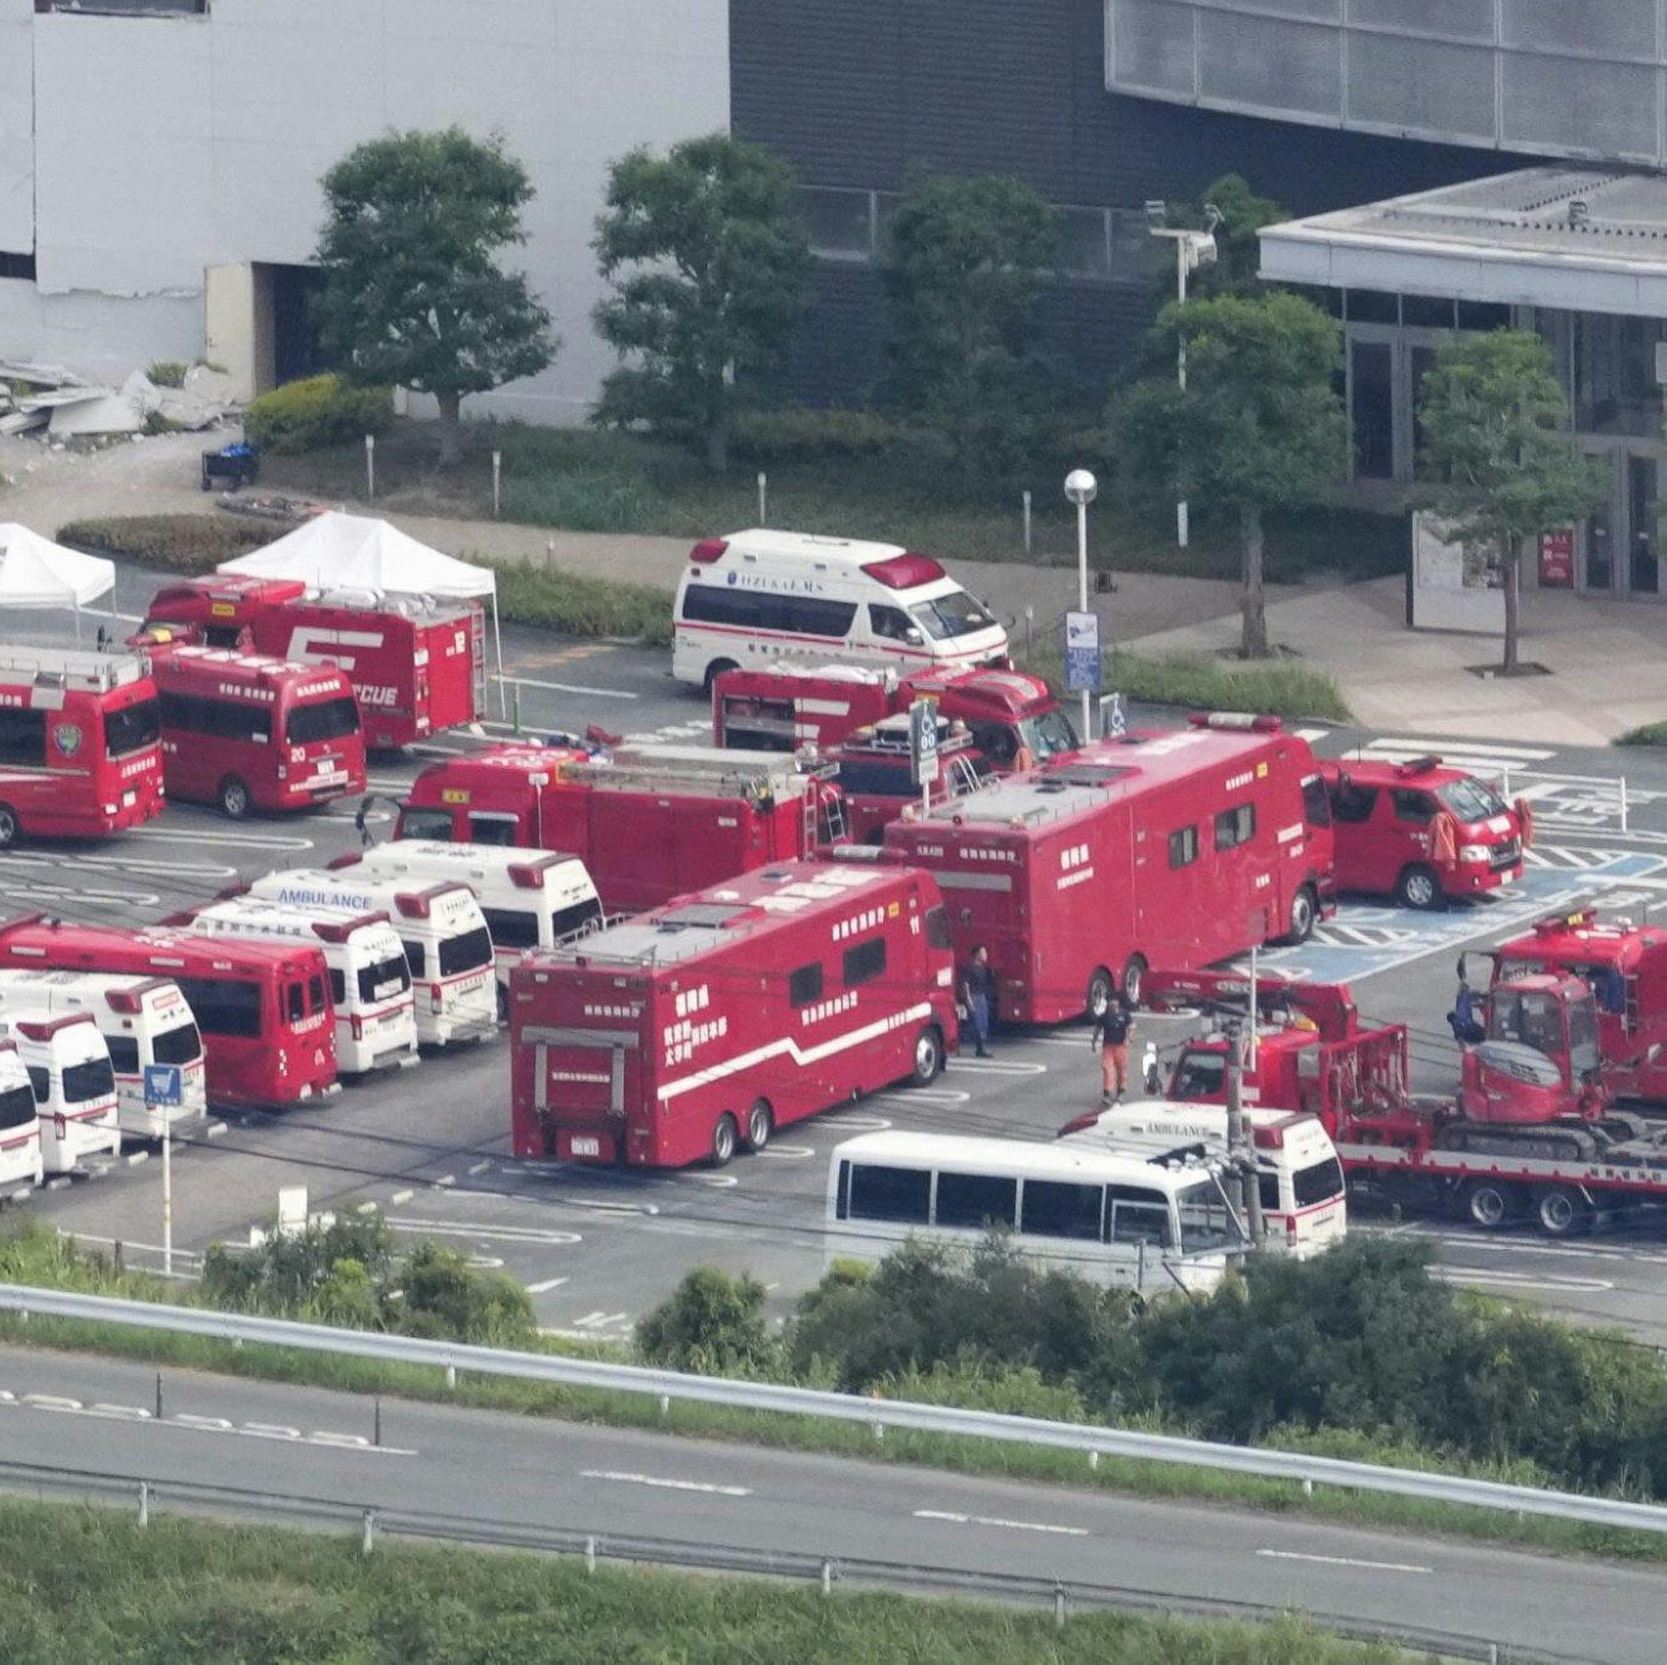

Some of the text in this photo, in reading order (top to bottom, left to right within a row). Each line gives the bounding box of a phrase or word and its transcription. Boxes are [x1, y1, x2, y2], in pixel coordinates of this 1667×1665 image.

[352, 683, 399, 706] CUE
[278, 888, 373, 910] AMBULANCE
[1148, 1121, 1209, 1137] AMBULANCE
